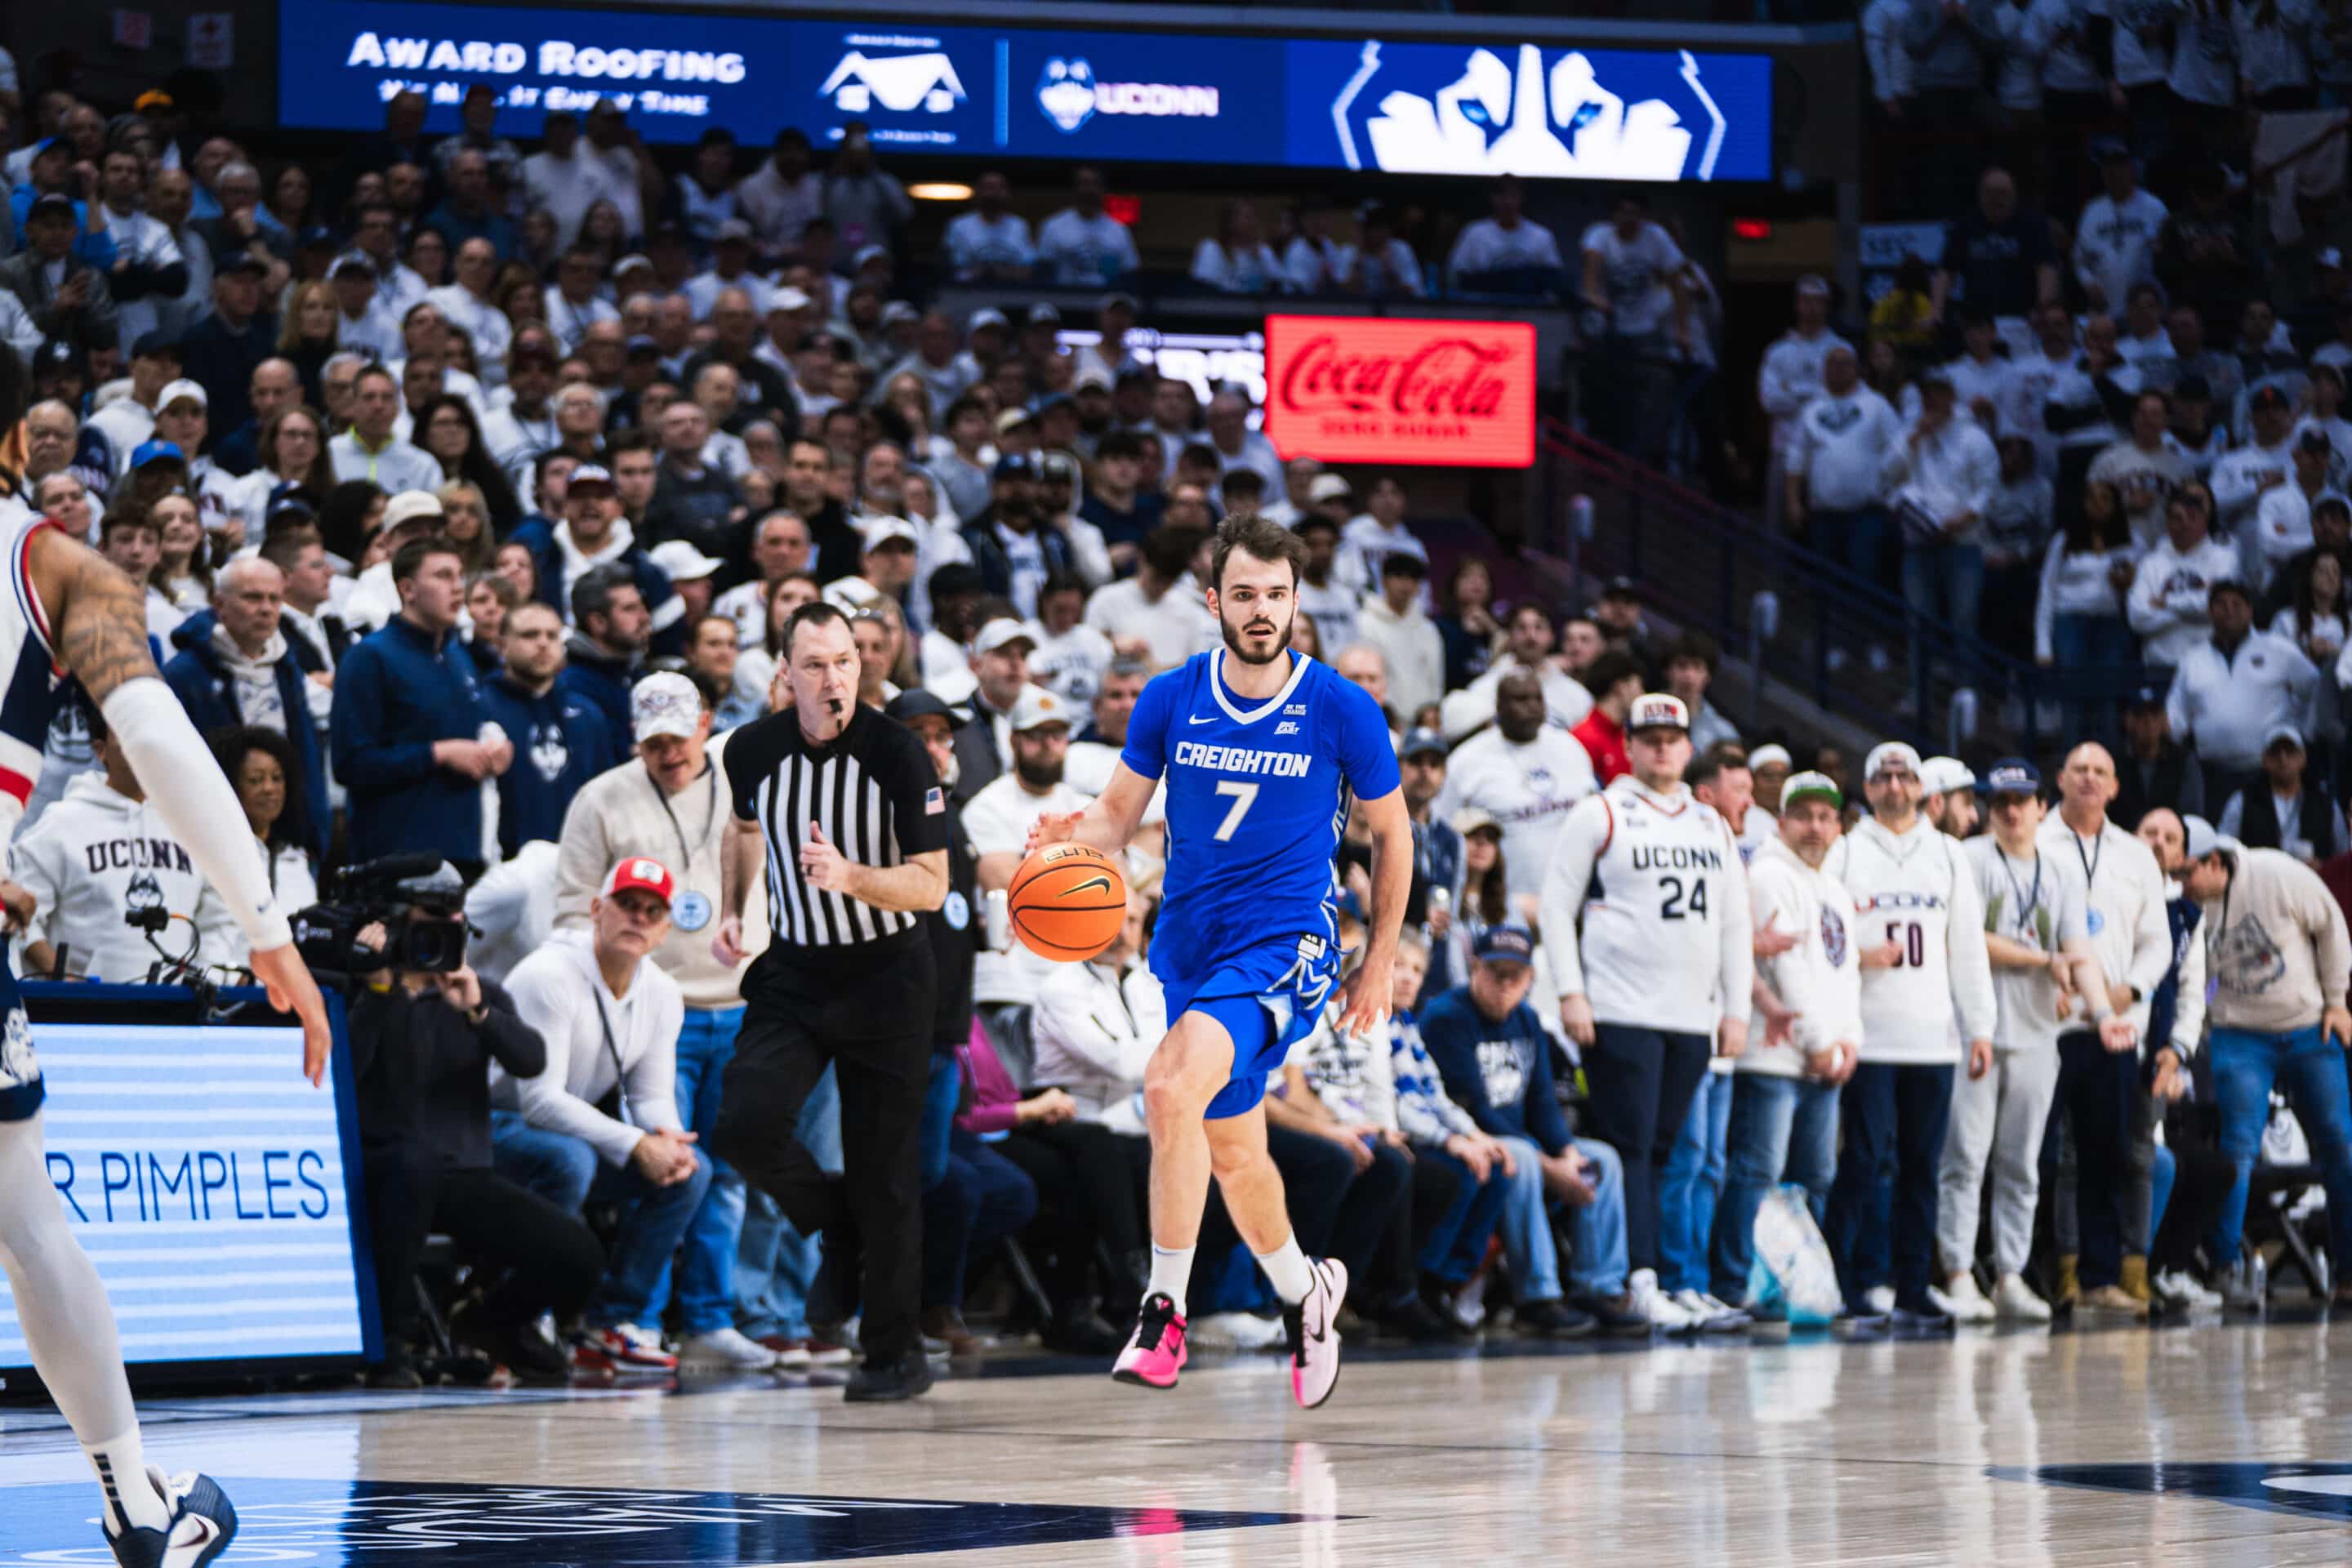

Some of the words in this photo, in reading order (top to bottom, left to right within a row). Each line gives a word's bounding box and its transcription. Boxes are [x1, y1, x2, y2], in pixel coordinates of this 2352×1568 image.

[346, 31, 527, 74] AWARD
[537, 40, 746, 84] ROOFING
[1094, 82, 1218, 117] UCONN
[1174, 741, 1312, 777] CREIGHTON
[1213, 779, 1260, 842] 7
[85, 837, 193, 875] UCONN
[1633, 844, 1723, 871] UCONN
[1659, 875, 1708, 921] 24
[1853, 893, 1947, 915] UCONN
[100, 1150, 330, 1223] PIMPLES
